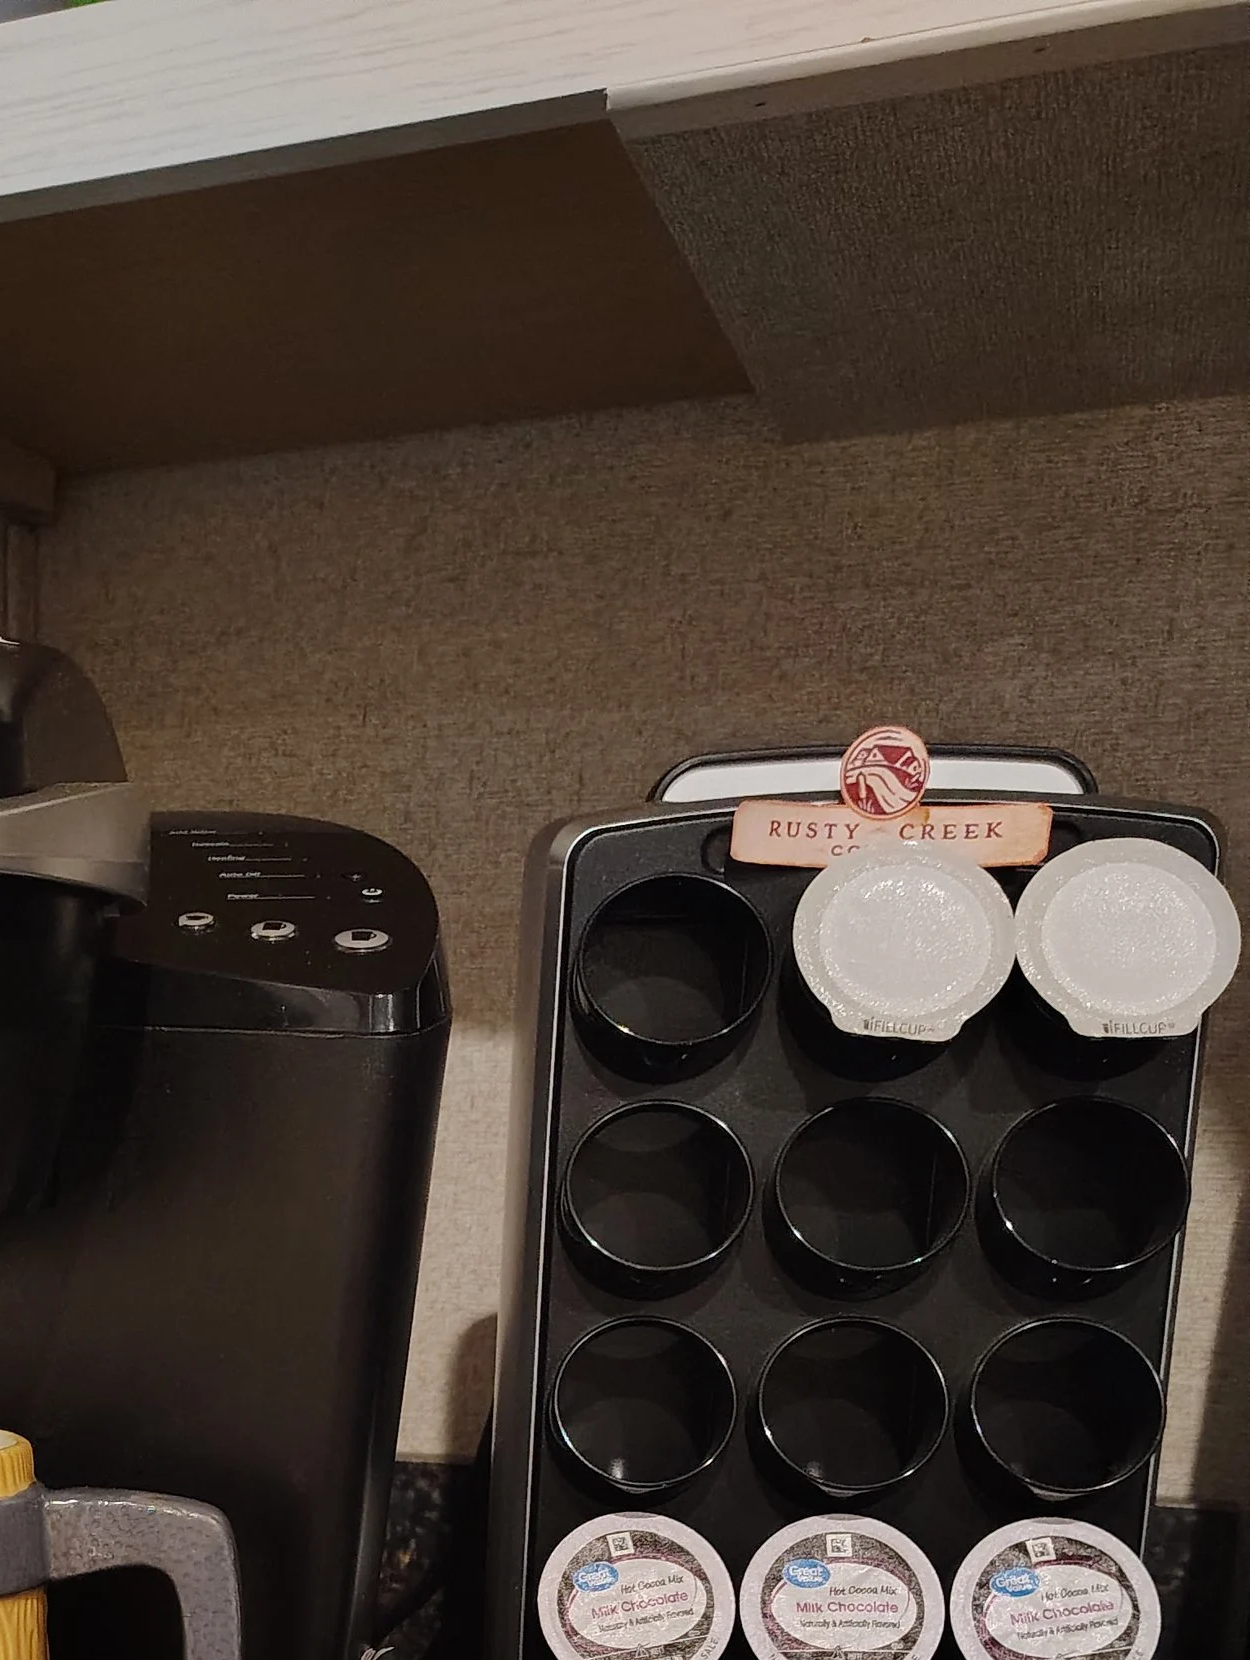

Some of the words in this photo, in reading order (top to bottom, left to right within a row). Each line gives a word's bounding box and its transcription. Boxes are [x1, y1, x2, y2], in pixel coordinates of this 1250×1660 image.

[769, 820, 860, 840] RUSTY
[900, 821, 1003, 840] CREEK
[789, 1565, 823, 1577] Great
[637, 1579, 666, 1591] Cocoa
[668, 1574, 684, 1584] Mix
[996, 1574, 1031, 1587] Great
[829, 1586, 845, 1597] Hot
[848, 1586, 878, 1595] Cocoa
[880, 1586, 898, 1595] Mix
[591, 1605, 619, 1620] Milk
[621, 1591, 689, 1613] Chocolate
[796, 1602, 822, 1614] Milk
[827, 1601, 898, 1614] Chocolate
[1009, 1611, 1040, 1626] Milk
[1043, 1600, 1115, 1621] Chocolate
